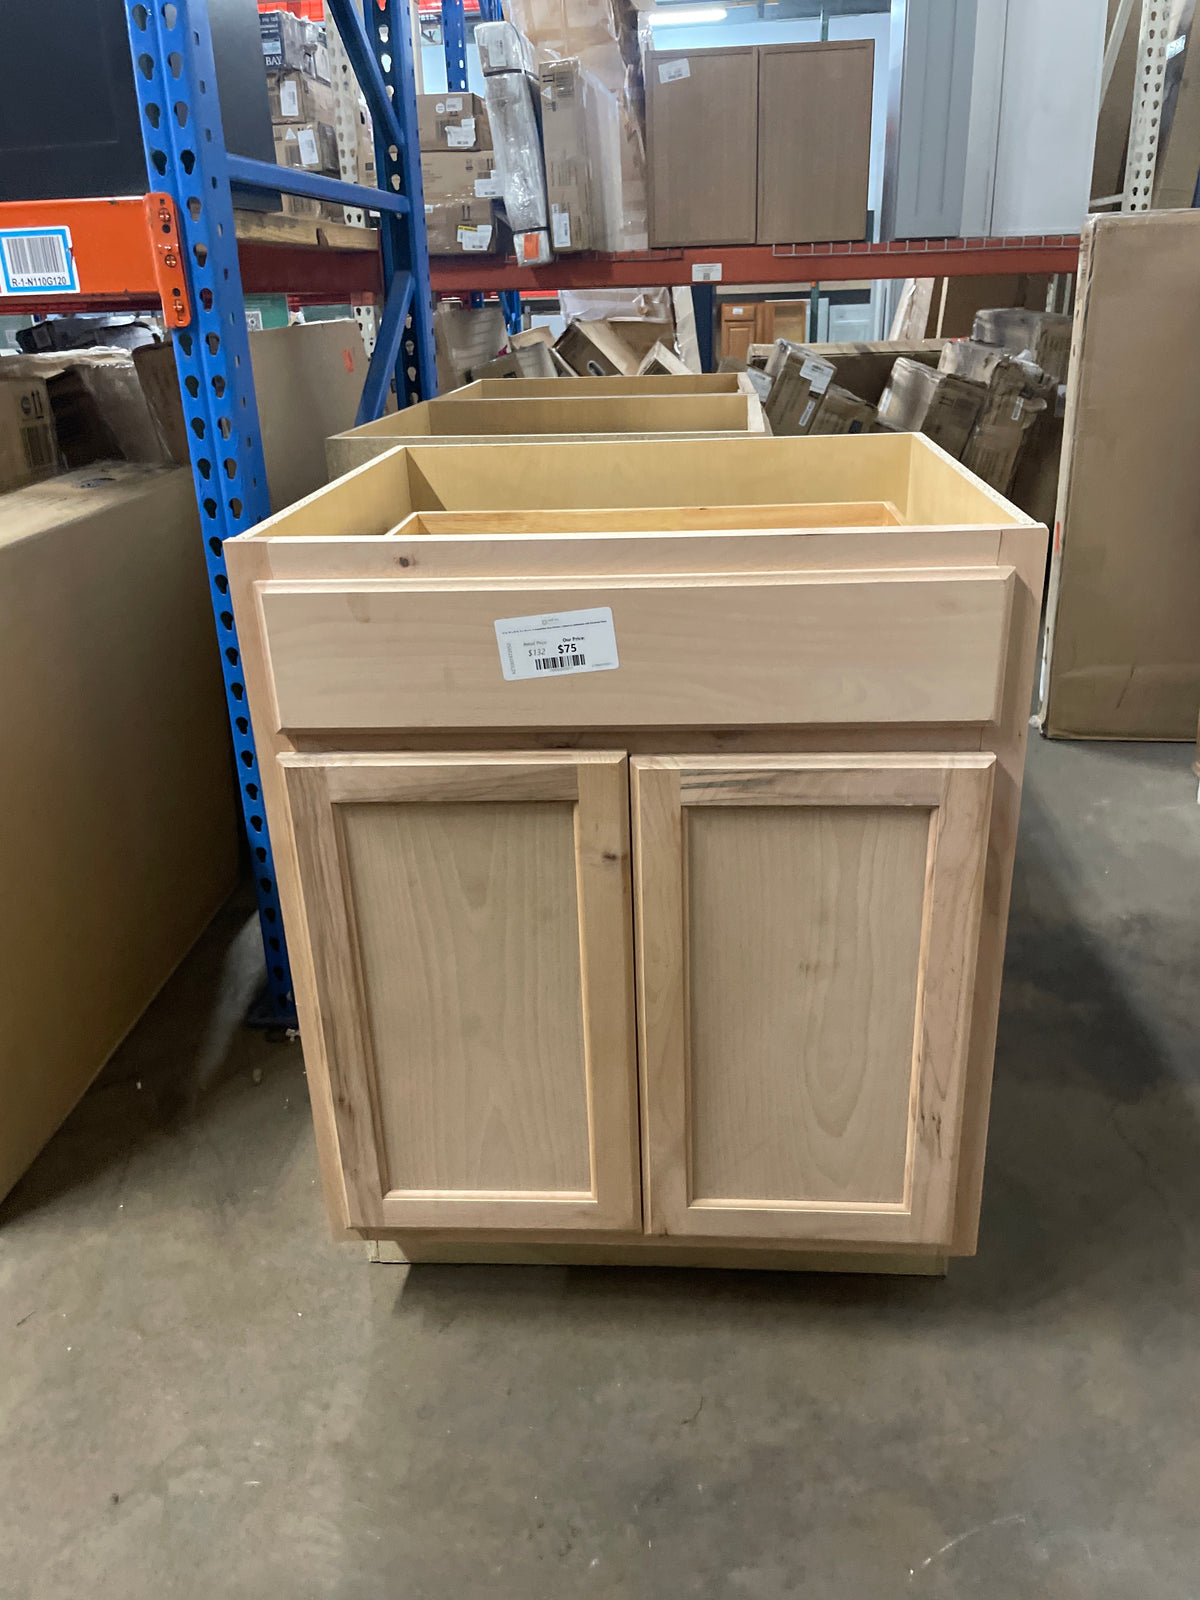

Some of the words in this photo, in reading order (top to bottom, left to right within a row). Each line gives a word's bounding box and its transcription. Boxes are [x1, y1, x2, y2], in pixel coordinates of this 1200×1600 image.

[265, 56, 282, 66] BAY
[12, 276, 67, 287] R-1-N110G120
[528, 648, 546, 657] $132
[557, 643, 577, 654] $75
